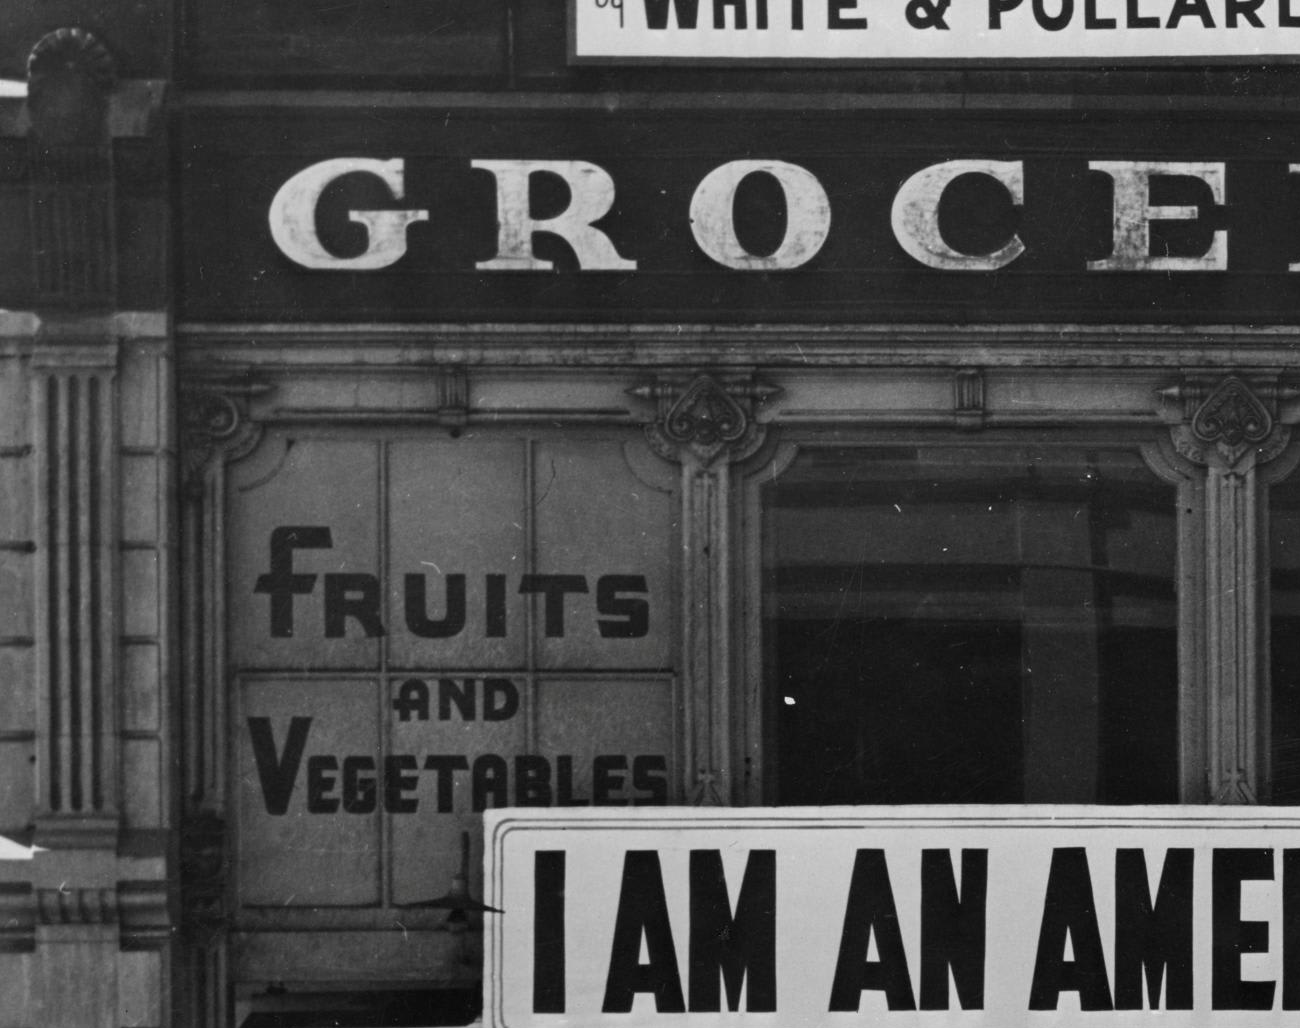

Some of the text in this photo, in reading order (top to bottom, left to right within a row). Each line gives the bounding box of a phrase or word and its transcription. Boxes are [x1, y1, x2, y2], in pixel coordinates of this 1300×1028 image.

[393, 678, 520, 722] AND
[247, 716, 669, 816] VEGETABLES
[532, 849, 567, 1014] I
[601, 849, 777, 1014] AM
[828, 847, 989, 1012] AN
